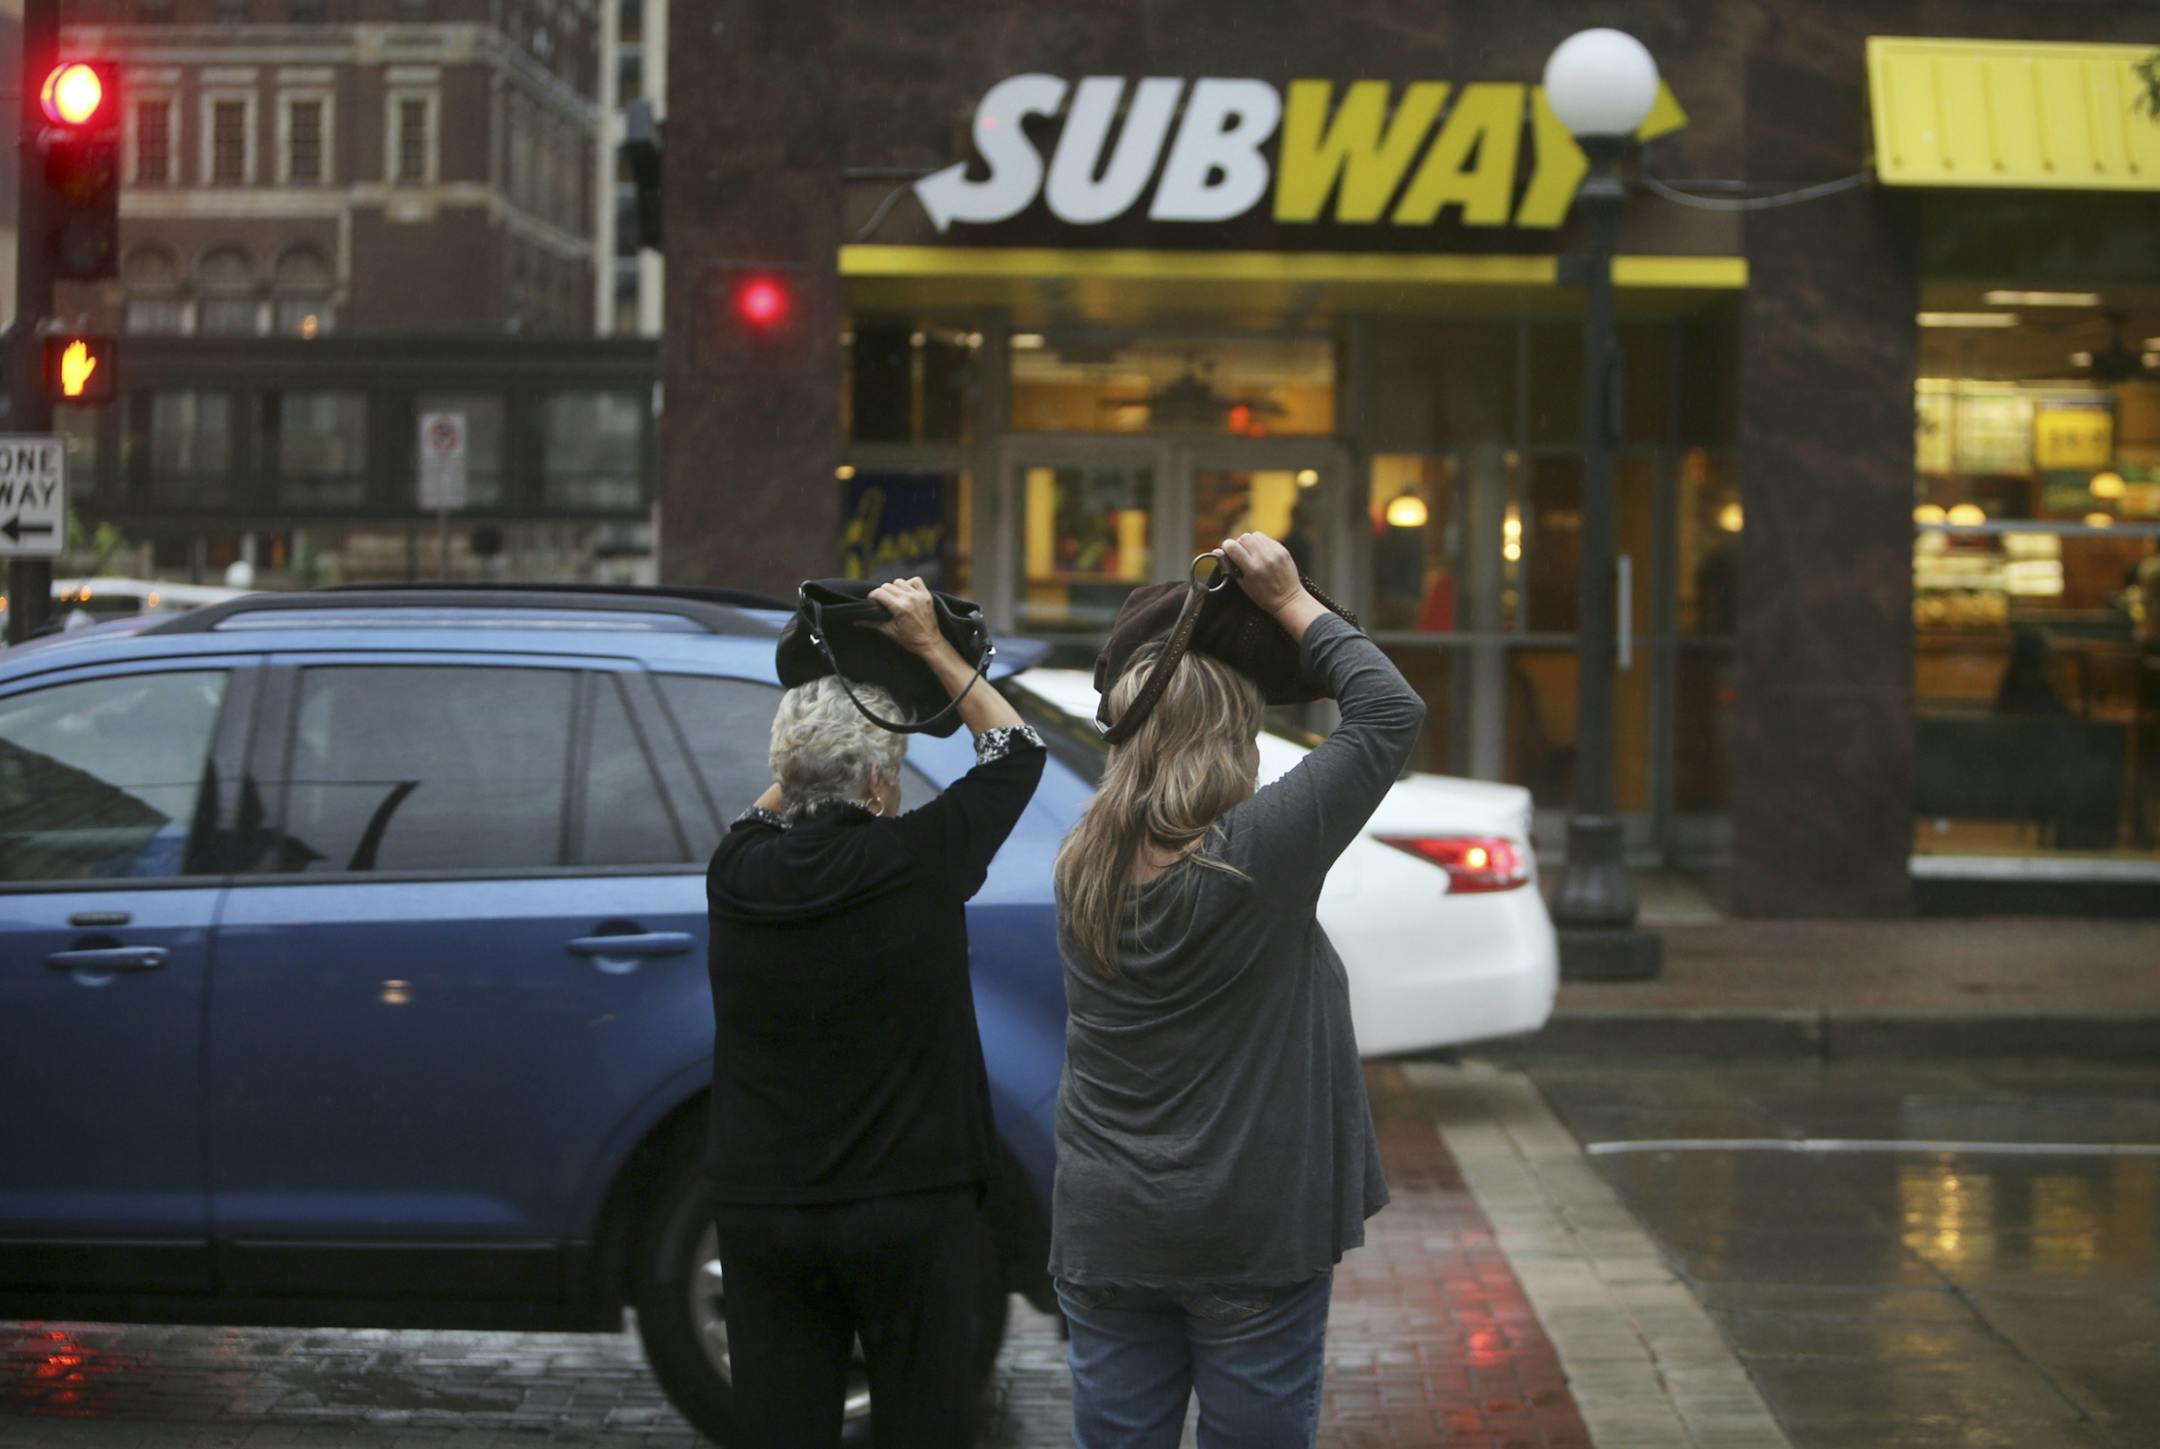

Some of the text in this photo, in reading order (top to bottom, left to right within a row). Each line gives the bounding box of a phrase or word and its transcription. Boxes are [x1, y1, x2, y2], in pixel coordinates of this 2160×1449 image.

[914, 74, 1688, 232] SUBWAY
[0, 447, 56, 475] ONE
[0, 479, 56, 509] WAY
